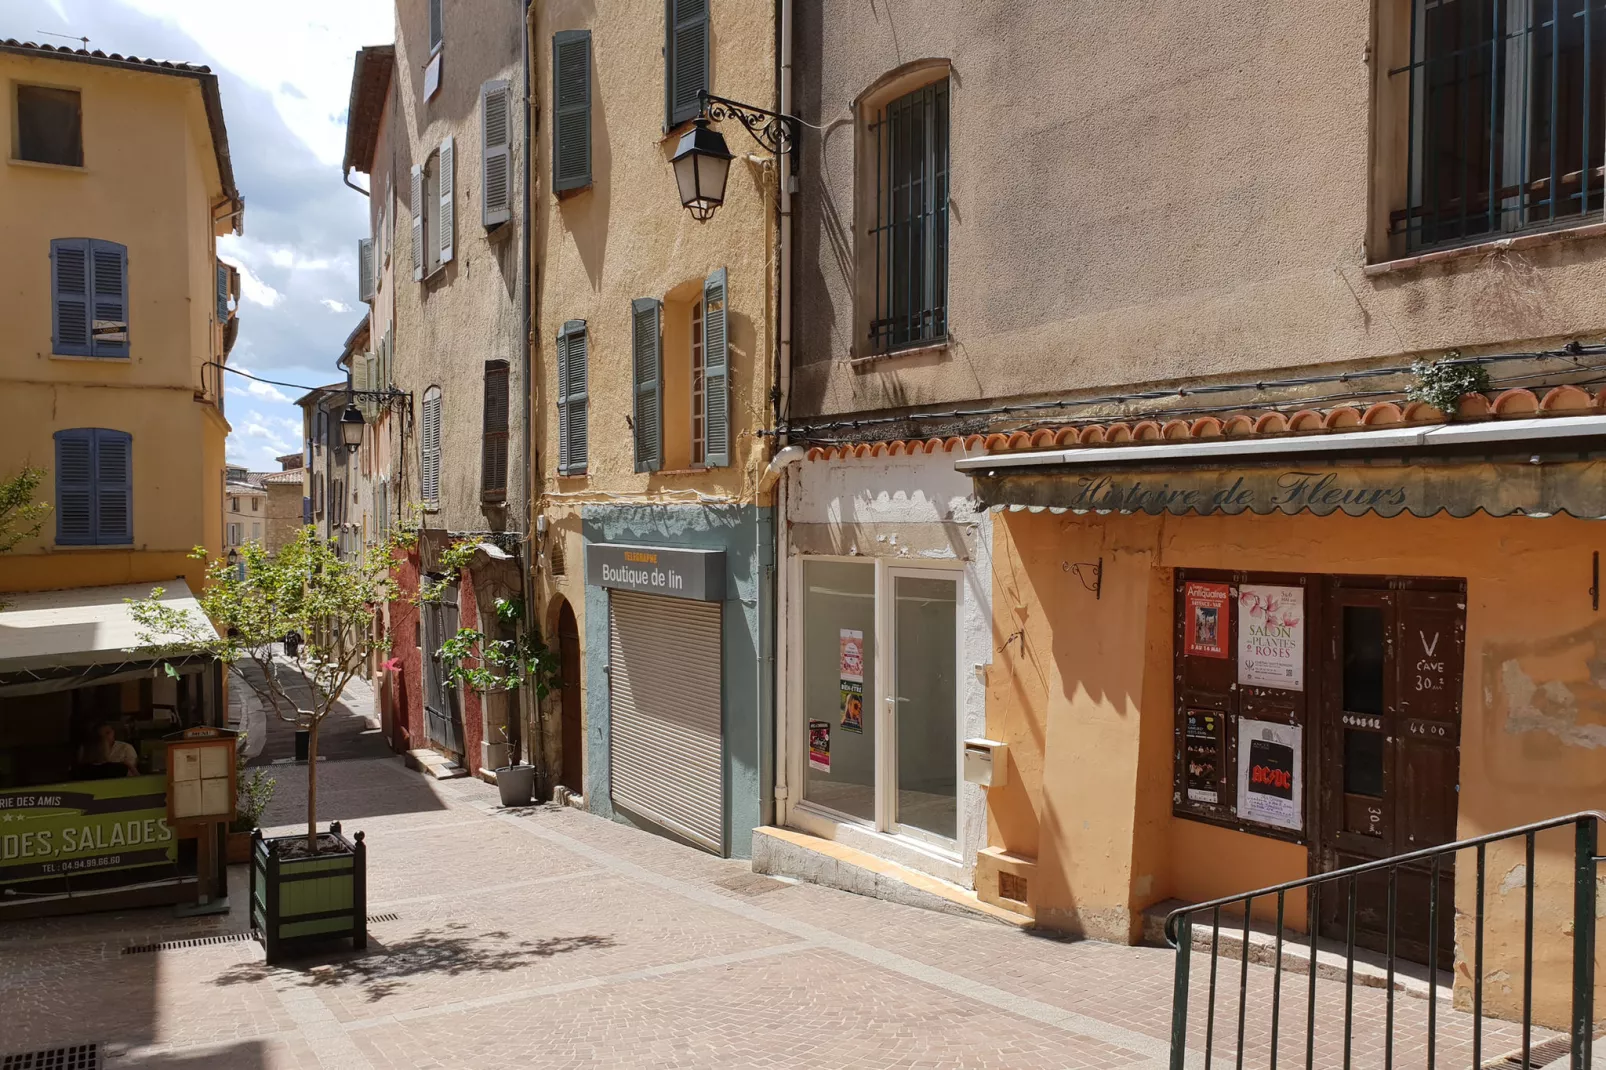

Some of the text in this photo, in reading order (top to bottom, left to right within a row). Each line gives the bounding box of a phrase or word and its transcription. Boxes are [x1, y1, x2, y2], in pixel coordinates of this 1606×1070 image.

[1070, 471, 1407, 506] Histoire de Fleurs
[602, 564, 683, 590] Boutique de lin
[1187, 586, 1227, 599] Antiquaires
[1249, 624, 1291, 638] SALON
[1252, 637, 1296, 649] PLANTES
[1255, 646, 1290, 658] ROSES
[1416, 662, 1445, 673] CAVE
[1251, 764, 1291, 790] AC/DC
[16, 796, 35, 807] DES
[37, 795, 61, 806] AMIS
